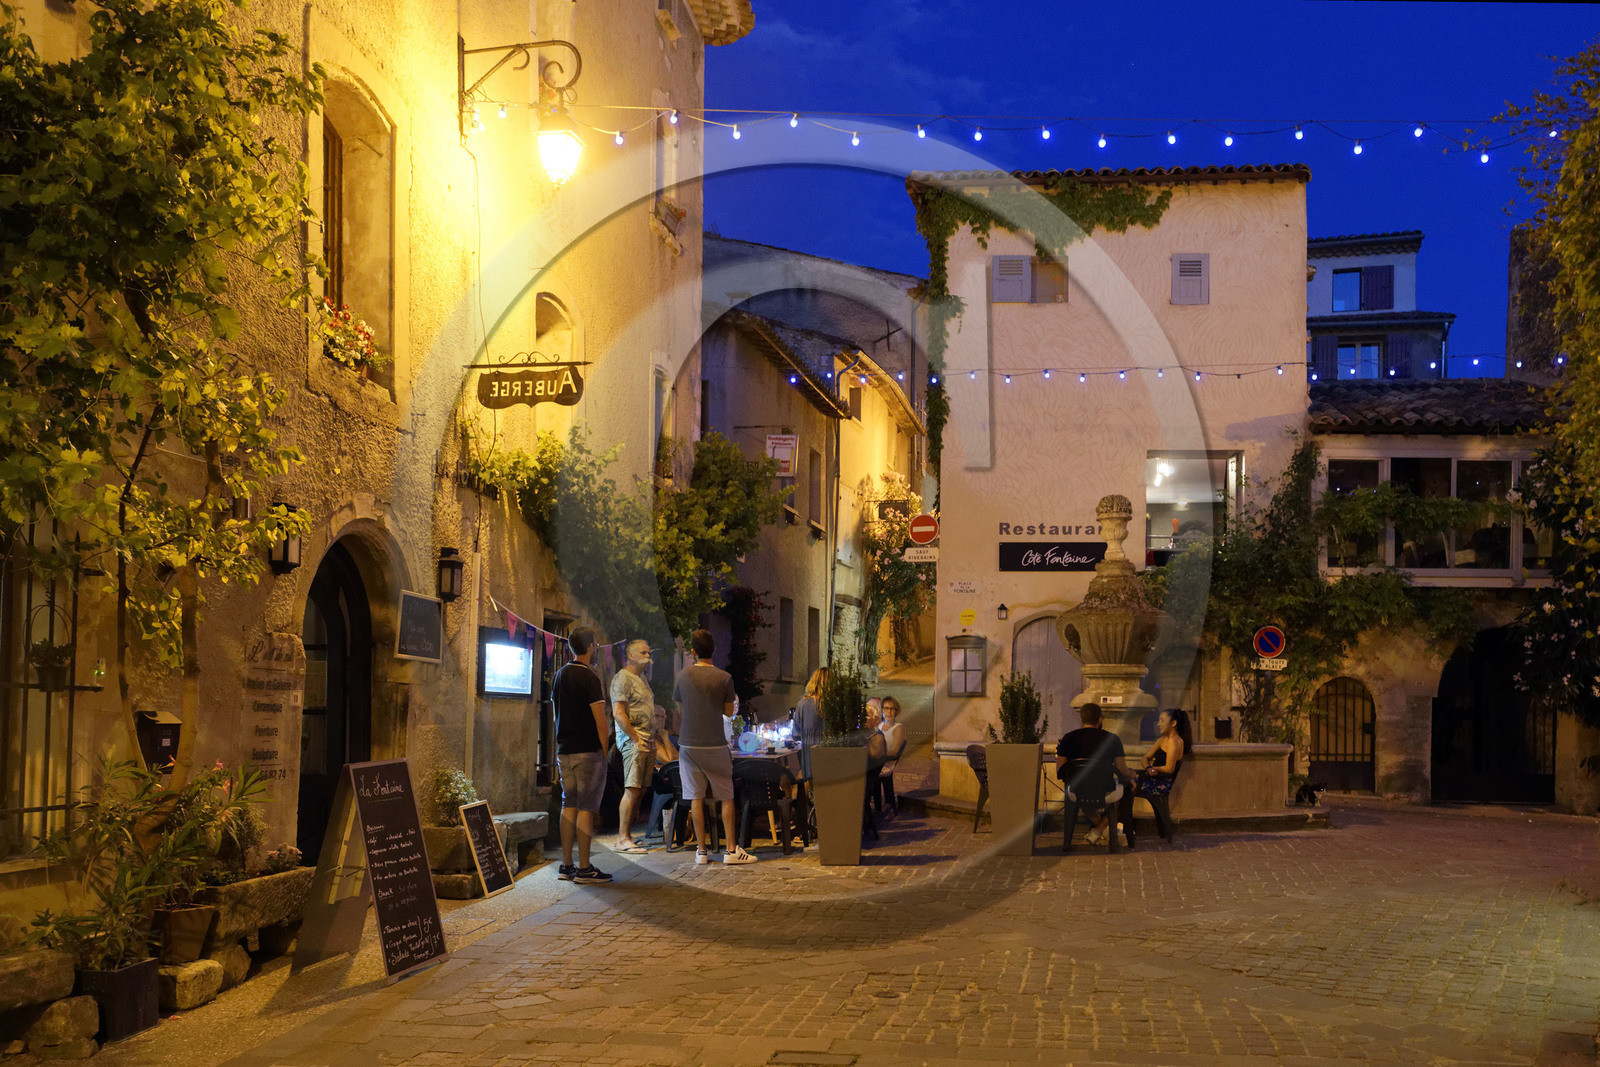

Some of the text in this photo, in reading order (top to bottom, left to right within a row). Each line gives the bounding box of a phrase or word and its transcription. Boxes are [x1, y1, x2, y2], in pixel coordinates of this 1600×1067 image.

[1022, 546, 1096, 567] Côté Fontaine
[255, 726, 279, 737] Peinture
[252, 748, 278, 762] Sculpture
[360, 772, 404, 798] La Fontaine
[378, 888, 394, 898] Snack
